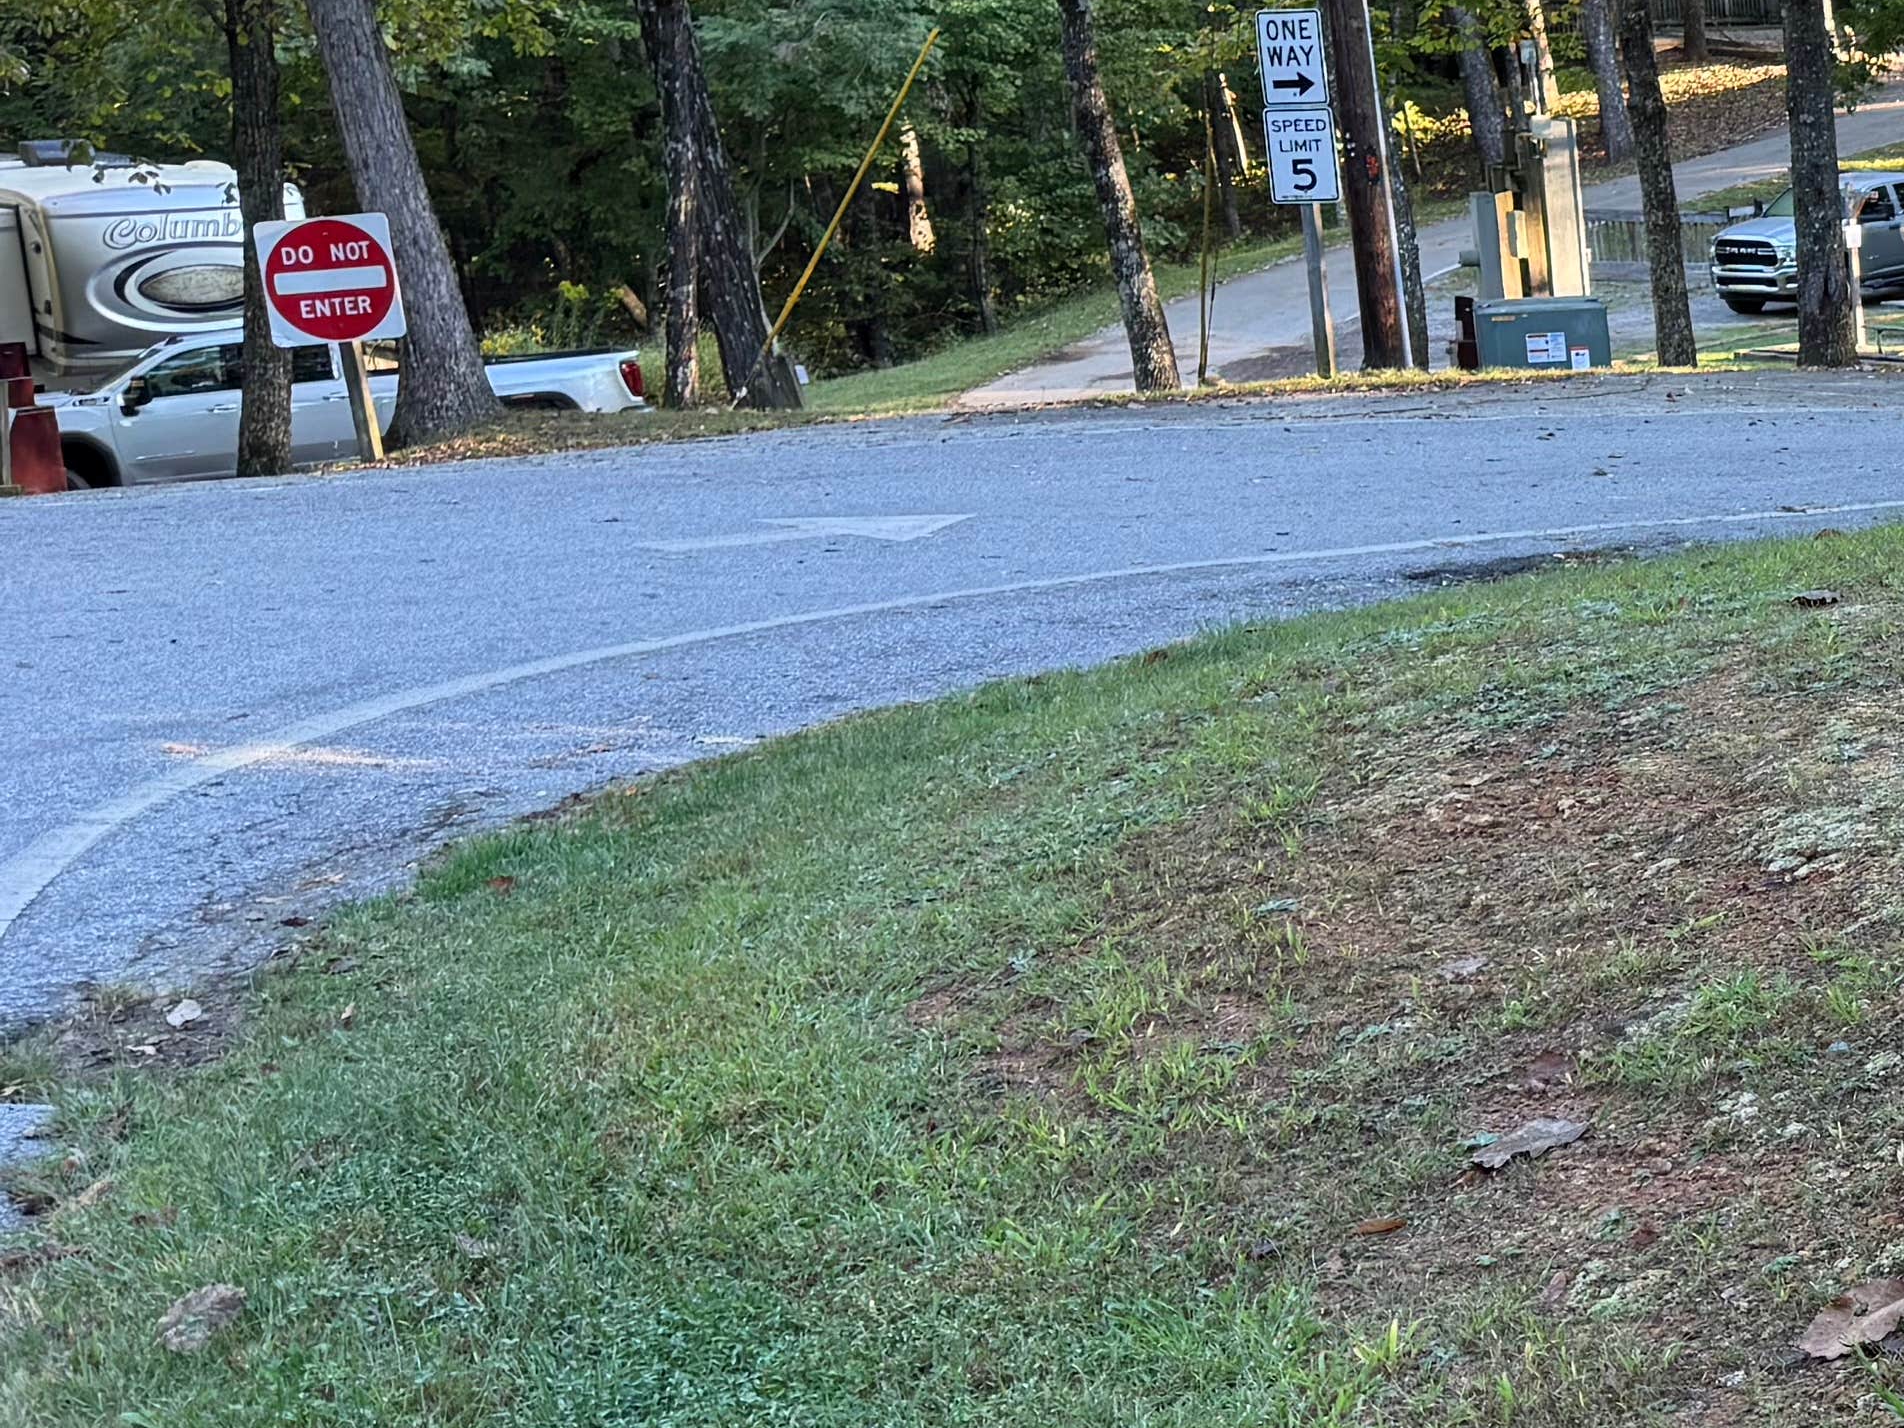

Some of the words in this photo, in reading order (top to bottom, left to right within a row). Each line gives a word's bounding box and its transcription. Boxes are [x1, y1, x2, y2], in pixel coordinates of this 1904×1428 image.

[1266, 19, 1312, 41] ONE
[1267, 45, 1313, 67] WAY
[1272, 119, 1326, 132] SPEED
[1280, 139, 1322, 152] LIMIT
[1292, 158, 1317, 191] 5
[281, 246, 314, 266] DO
[330, 241, 370, 262] NOT
[300, 296, 372, 319] ENTER
